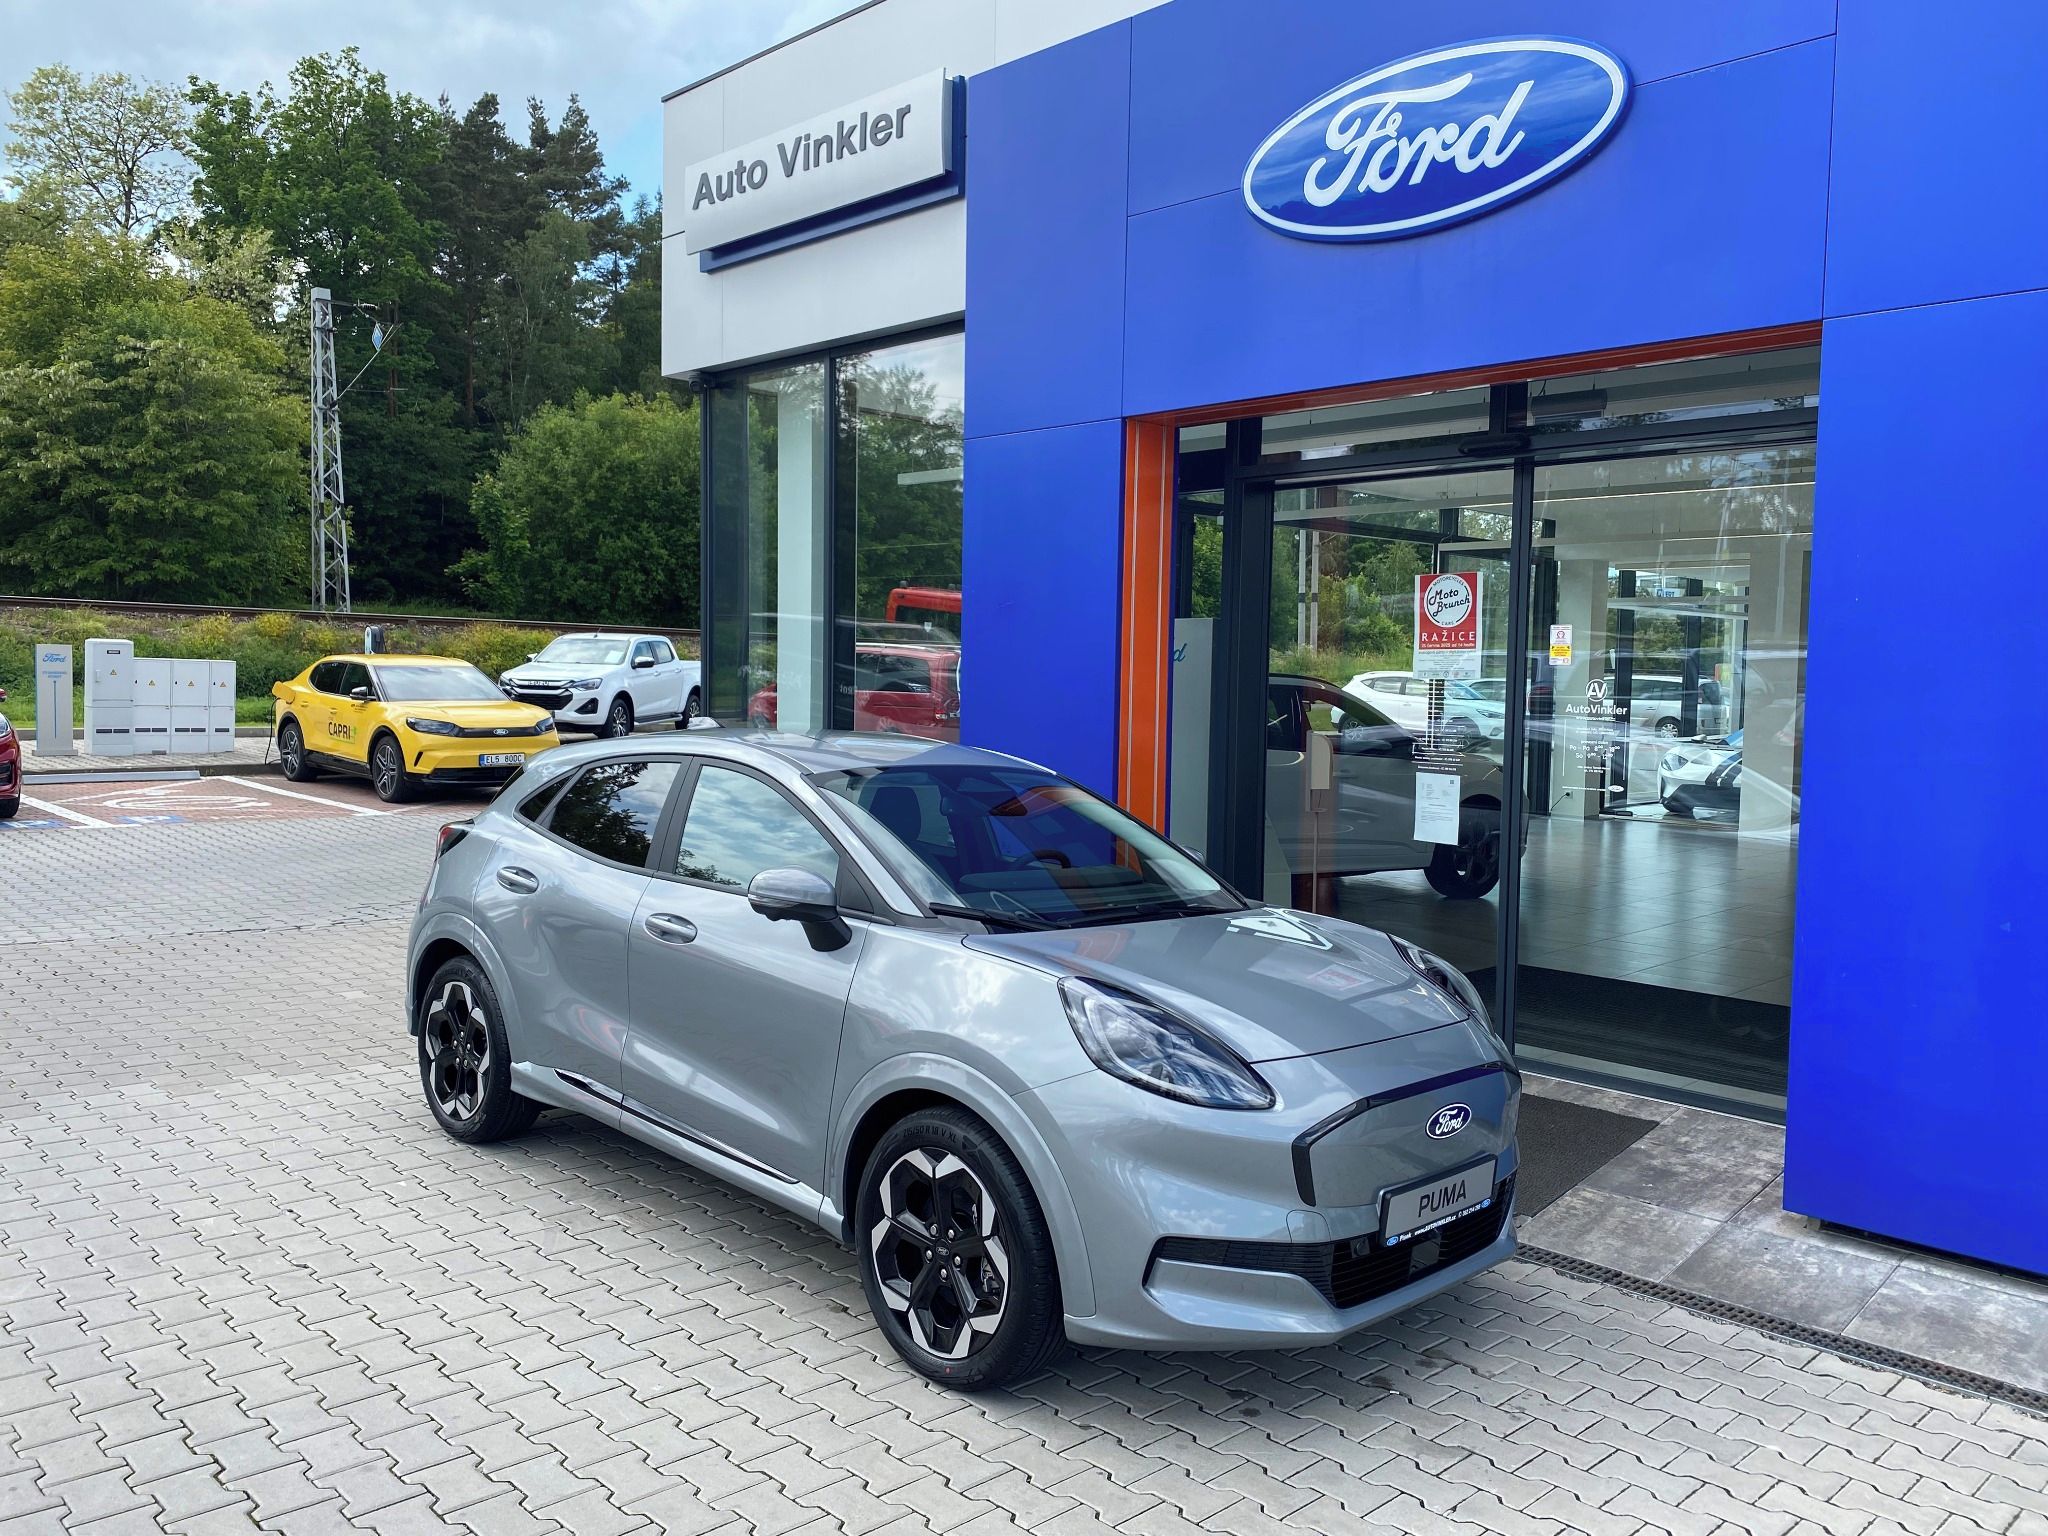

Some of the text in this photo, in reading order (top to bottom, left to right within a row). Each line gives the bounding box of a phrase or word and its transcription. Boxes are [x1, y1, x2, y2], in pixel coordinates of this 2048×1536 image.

[1303, 72, 1535, 207] Ford
[692, 103, 912, 211] Auto Vinkler
[1433, 576, 1464, 586] MOTORCYCLES
[1429, 589, 1459, 605] Moto
[1432, 595, 1470, 617] Brunch
[1422, 630, 1475, 641] RAŽICE
[42, 652, 67, 662] Ford
[1565, 703, 1628, 715] AutoVinkler
[328, 721, 351, 741] CAPRI
[486, 755, 500, 764] EL5
[1435, 1109, 1464, 1135] Ford
[1418, 1179, 1468, 1218] PUMA
